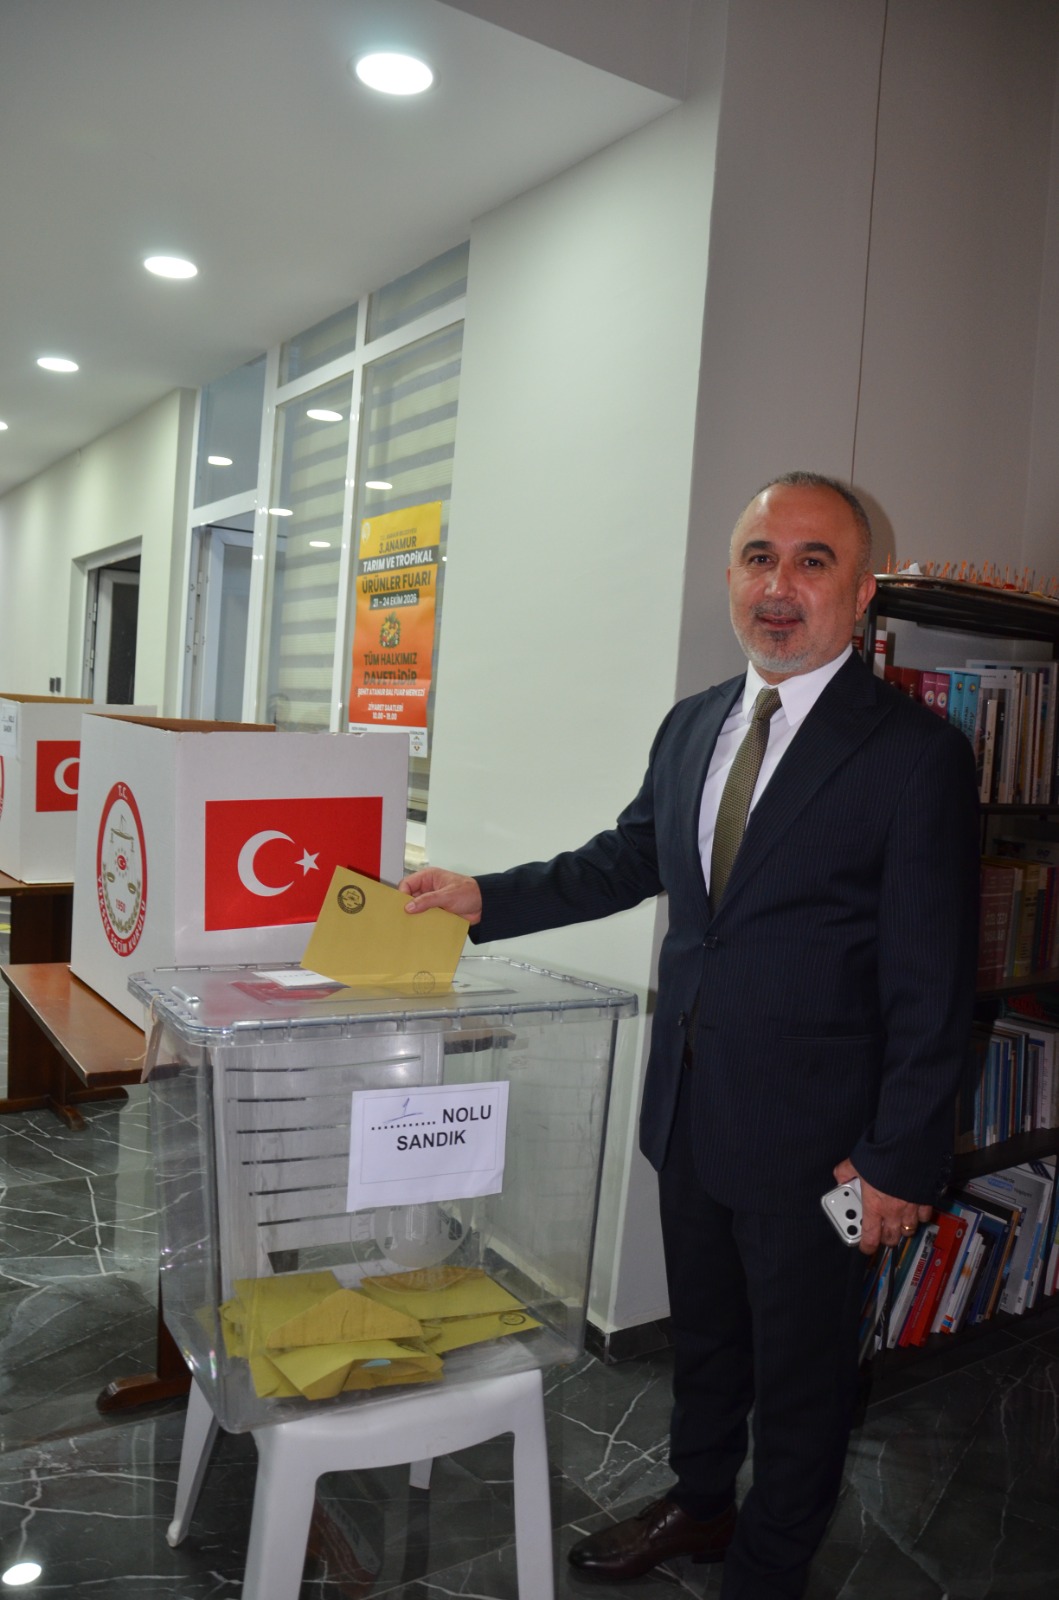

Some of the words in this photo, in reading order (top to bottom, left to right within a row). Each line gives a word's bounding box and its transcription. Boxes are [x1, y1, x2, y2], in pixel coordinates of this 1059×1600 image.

[363, 560, 385, 573] TARIM
[386, 558, 395, 569] VE
[396, 549, 433, 567] TROPİKAL
[362, 573, 401, 594] ÜRÜNLER
[403, 570, 431, 589] FUARI
[363, 651, 379, 666] TÜM
[381, 652, 417, 666] HALKIMIZ
[363, 669, 417, 685] DAVETLİDİR
[443, 1105, 492, 1124] NOLU
[396, 1129, 467, 1151] SANDIK
